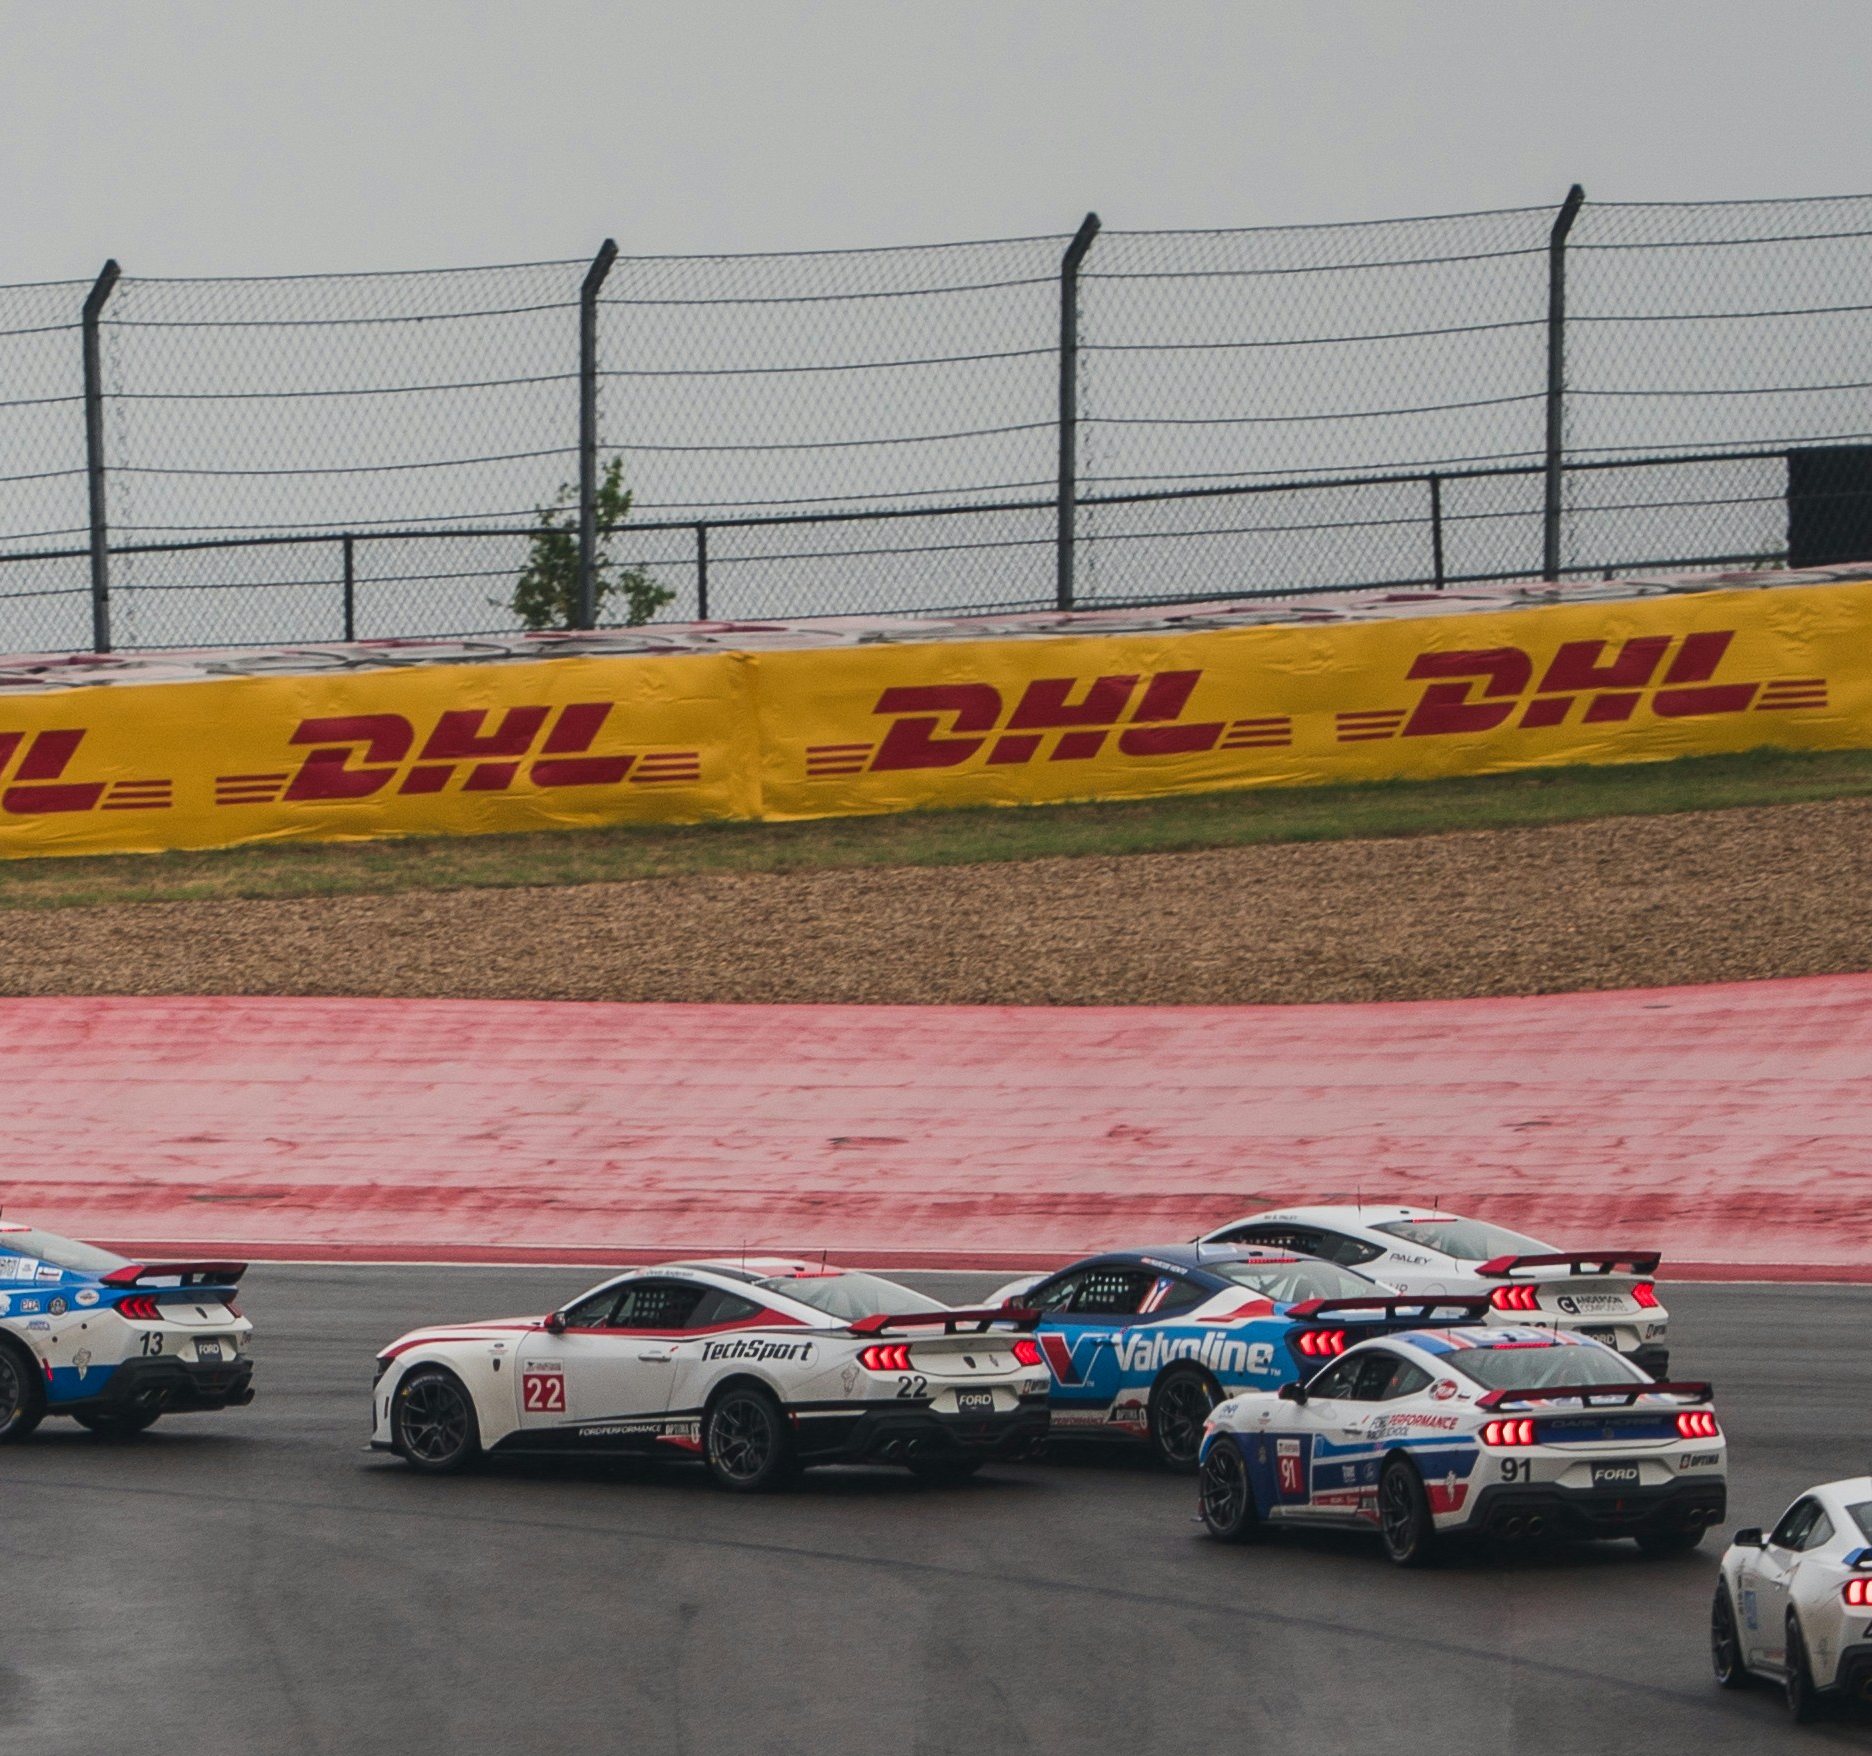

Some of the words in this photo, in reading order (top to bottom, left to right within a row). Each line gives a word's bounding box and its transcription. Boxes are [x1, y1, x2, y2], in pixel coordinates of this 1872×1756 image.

[1402, 630, 1759, 737] DHL
[870, 669, 1227, 772] DHL
[283, 702, 635, 801] DHL
[1390, 1253, 1432, 1265] PALEY
[139, 1331, 164, 1355] 13
[198, 1343, 220, 1354] FORD
[702, 1339, 813, 1362] TechSport
[1590, 1333, 1615, 1345] ORD
[1111, 1332, 1275, 1374] Valvoline
[527, 1377, 562, 1409] 22
[897, 1375, 928, 1398] 22
[959, 1394, 992, 1406] FORD
[1388, 1414, 1460, 1430] PERFORMANCE
[1501, 1458, 1532, 1482] 91
[1691, 1454, 1719, 1467] OPTIMA
[1282, 1459, 1297, 1489] 91
[1595, 1468, 1638, 1481] FORD
